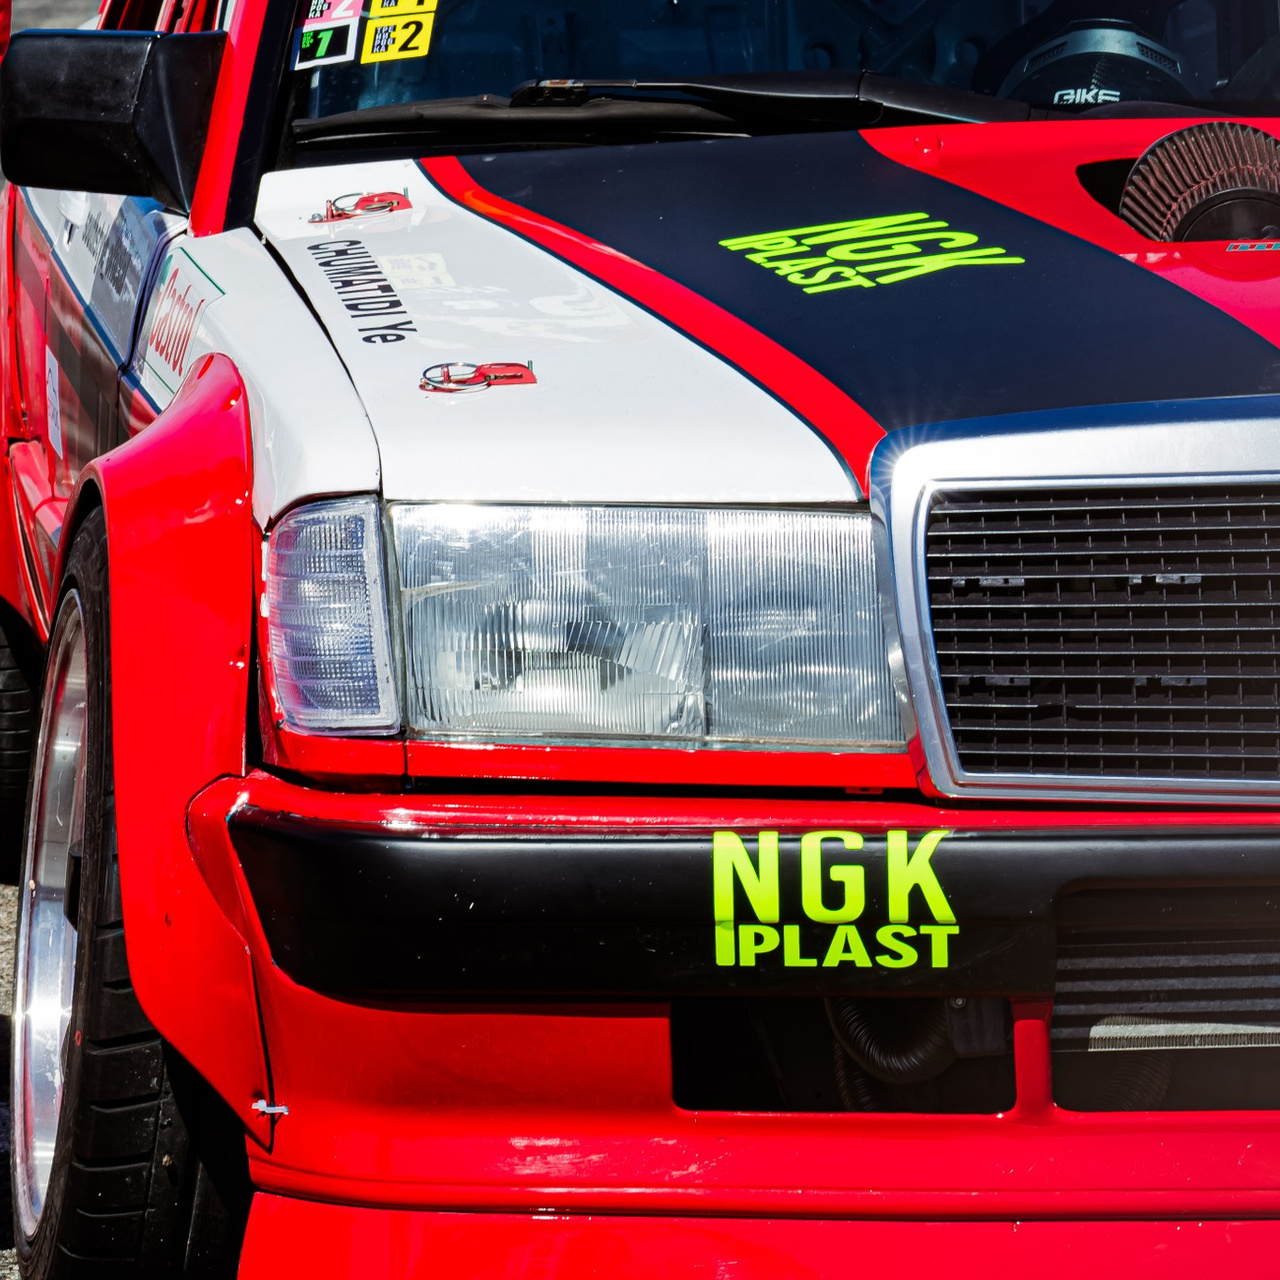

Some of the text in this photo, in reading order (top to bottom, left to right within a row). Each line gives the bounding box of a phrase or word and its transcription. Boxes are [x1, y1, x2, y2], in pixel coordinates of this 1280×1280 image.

[315, 30, 334, 58] 1
[398, 20, 423, 52] 2
[718, 211, 1026, 285] NGK
[726, 235, 877, 294] PLAST
[149, 267, 206, 377] Castrol
[306, 239, 419, 344] CHUMATIDI Ye
[713, 830, 957, 945] NGK
[738, 923, 960, 968] PLAST
